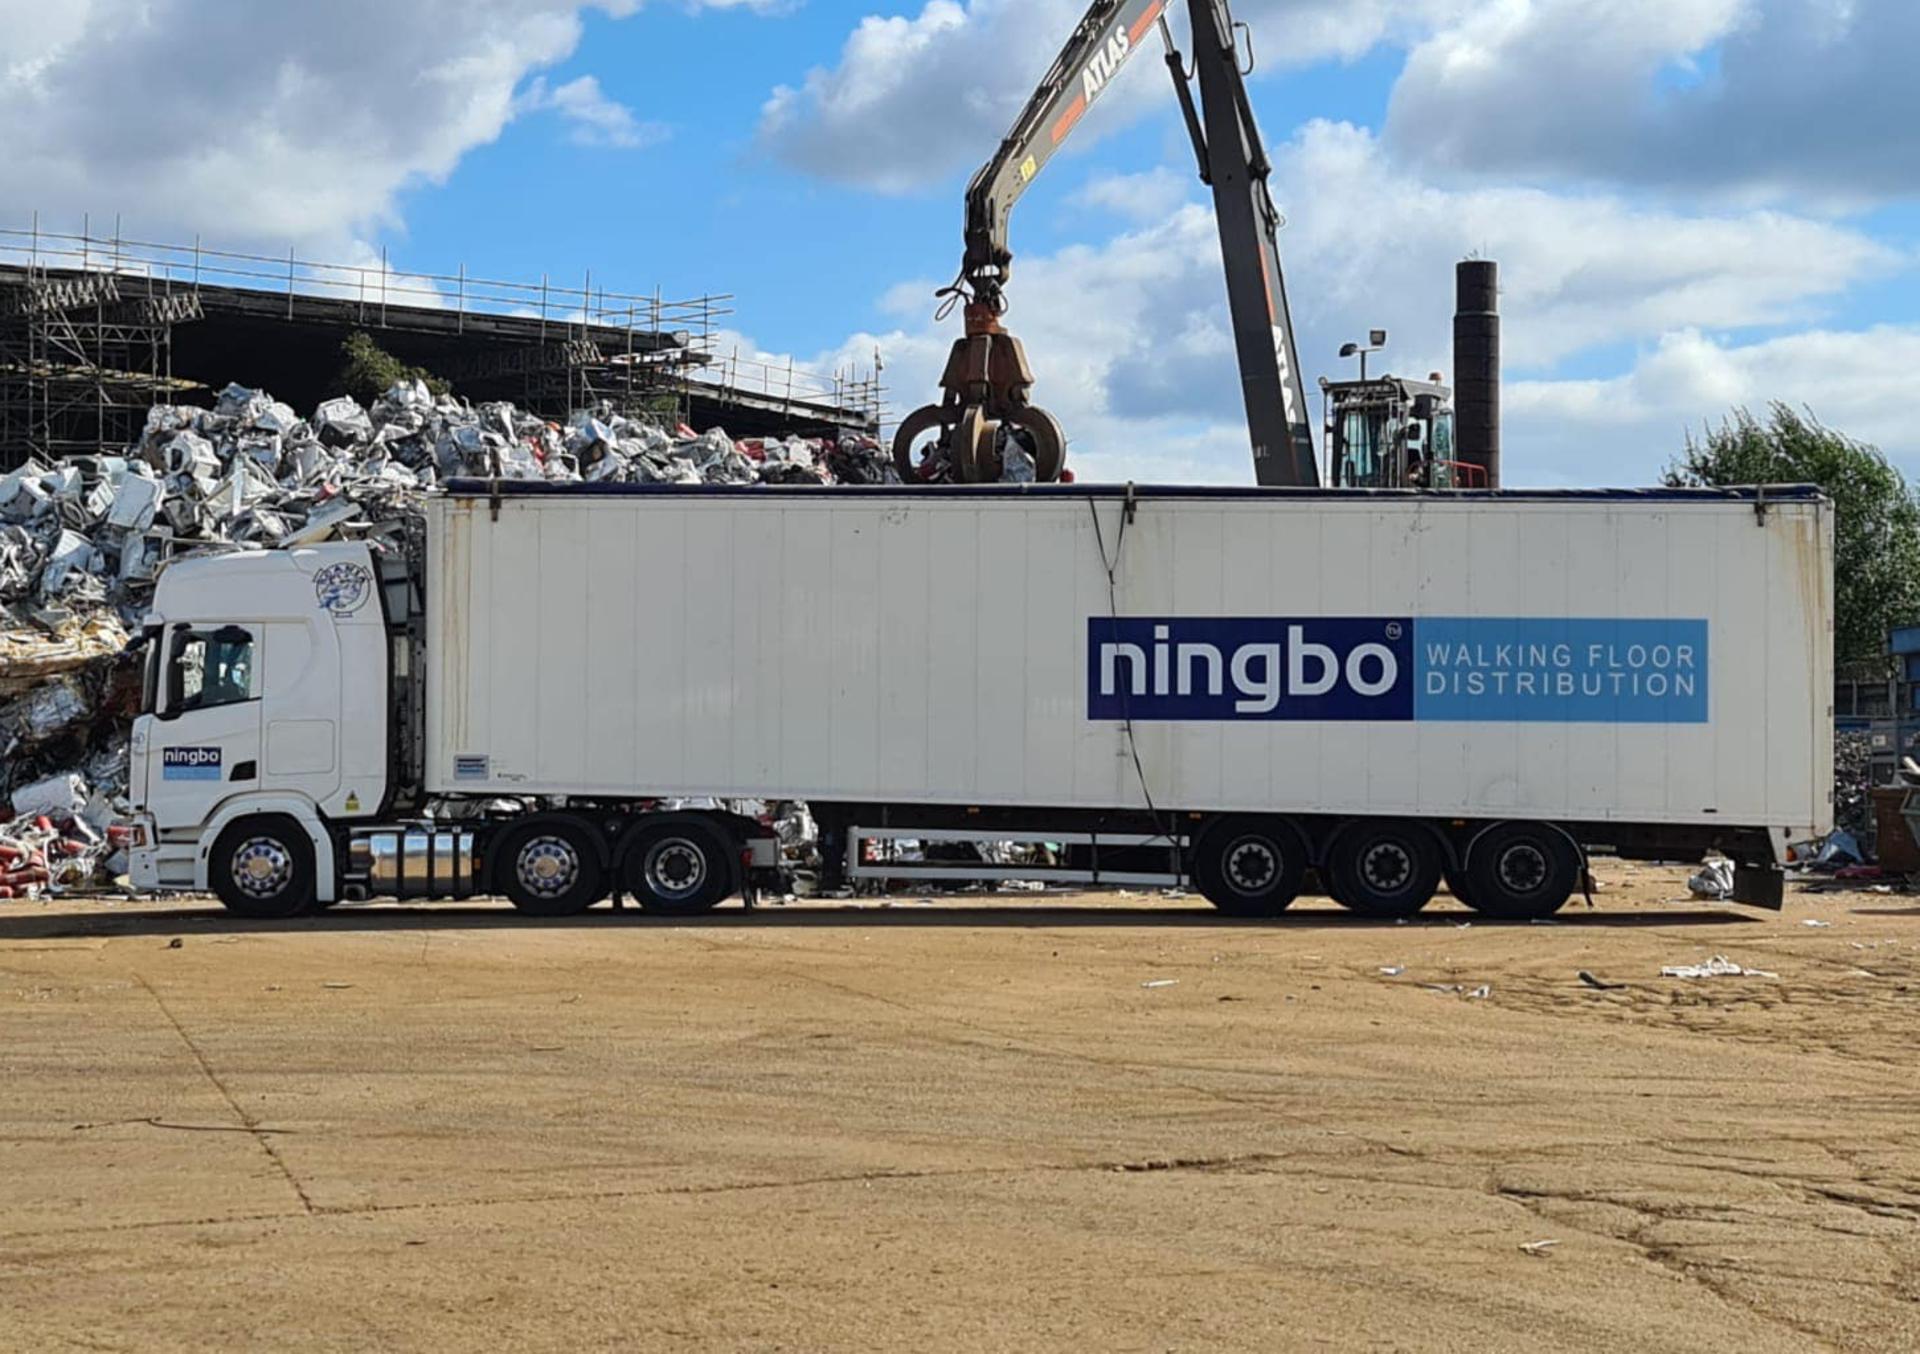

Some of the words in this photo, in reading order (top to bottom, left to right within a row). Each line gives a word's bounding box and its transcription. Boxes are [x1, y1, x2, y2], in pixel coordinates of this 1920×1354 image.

[1082, 25, 1129, 102] ATLAS
[1427, 644, 1571, 667] WALKING
[1589, 645, 1694, 667] FLOOR
[1101, 625, 1398, 713] ningbo
[1427, 672, 1694, 696] DISTRIBUTION
[164, 749, 219, 765] ningbo
